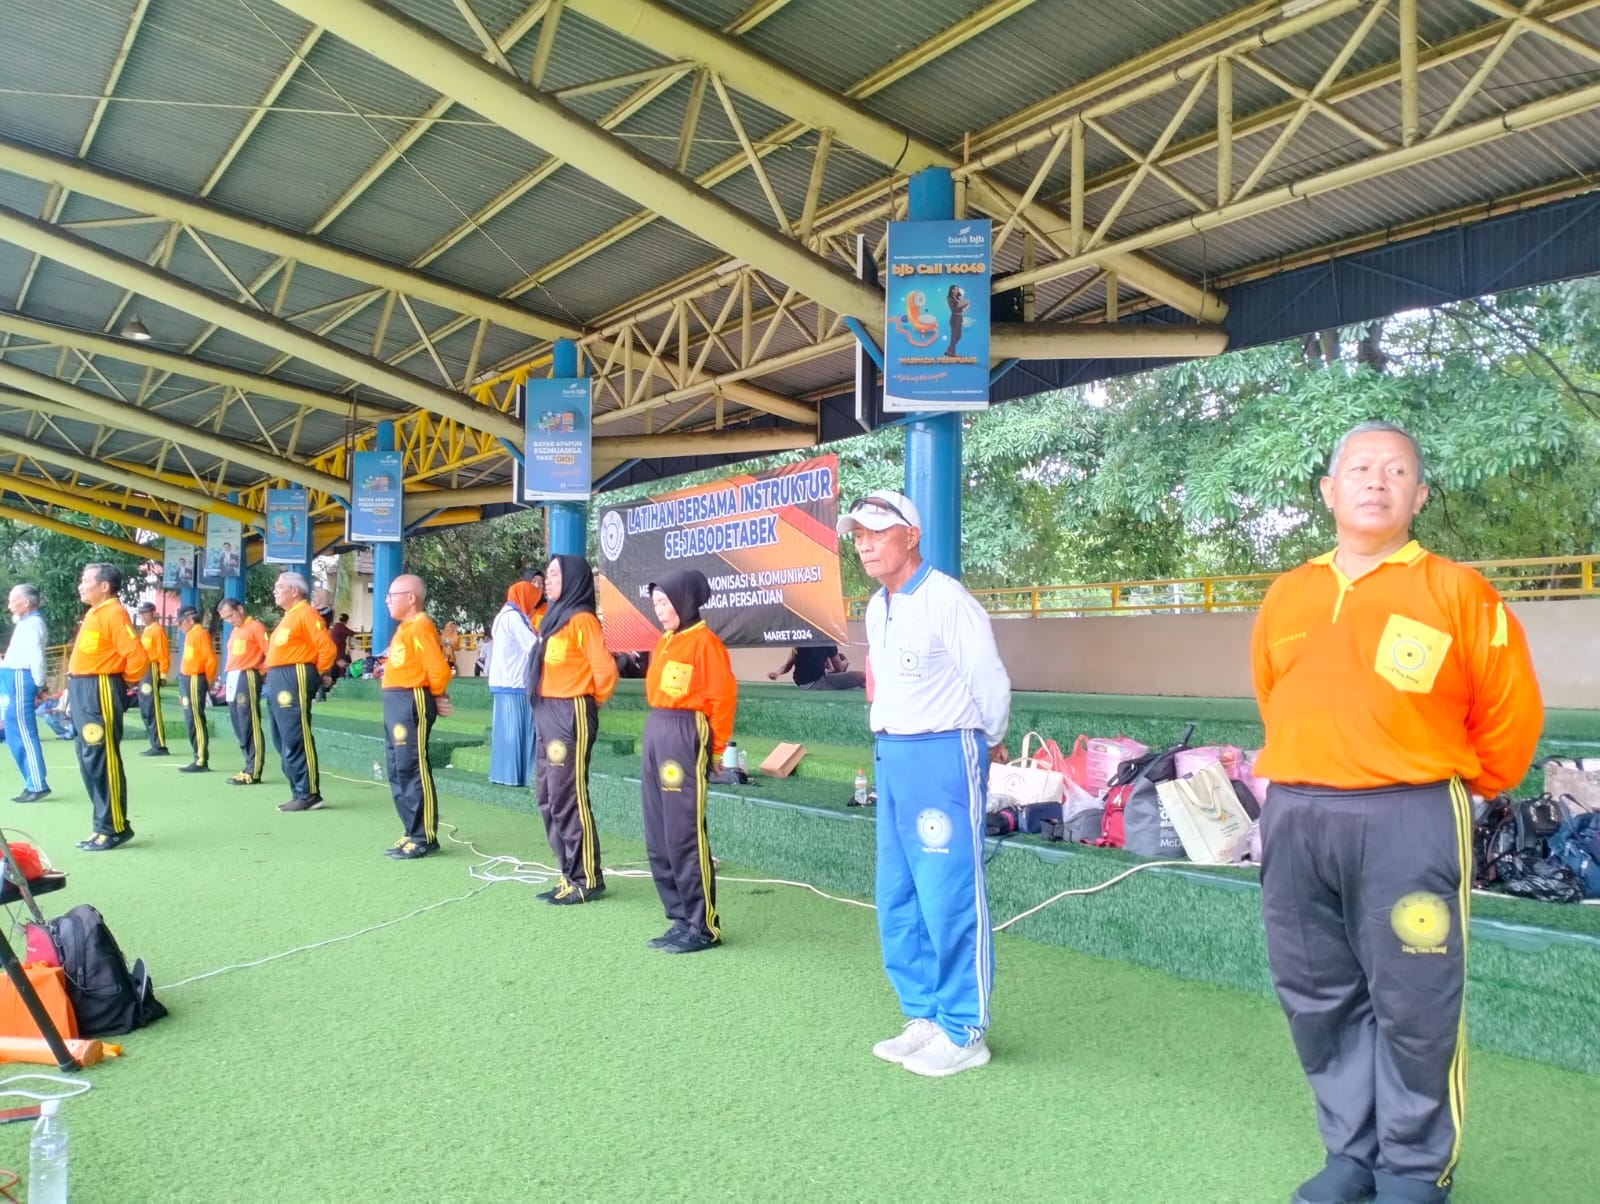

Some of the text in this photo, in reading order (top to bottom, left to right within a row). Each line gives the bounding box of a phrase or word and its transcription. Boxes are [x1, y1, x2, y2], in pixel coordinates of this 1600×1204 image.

[948, 234, 985, 245] bank bjb
[892, 264, 915, 277] bjb
[917, 263, 943, 274] Call
[628, 467, 833, 534] LATIHAN BERSAMA INSTRUKTUR
[750, 576, 757, 588] &
[759, 566, 822, 587] KOMUNIKASI
[729, 589, 784, 608] PERSATUAN
[763, 630, 813, 641] MARET 2024
[1159, 839, 1182, 848] McD
